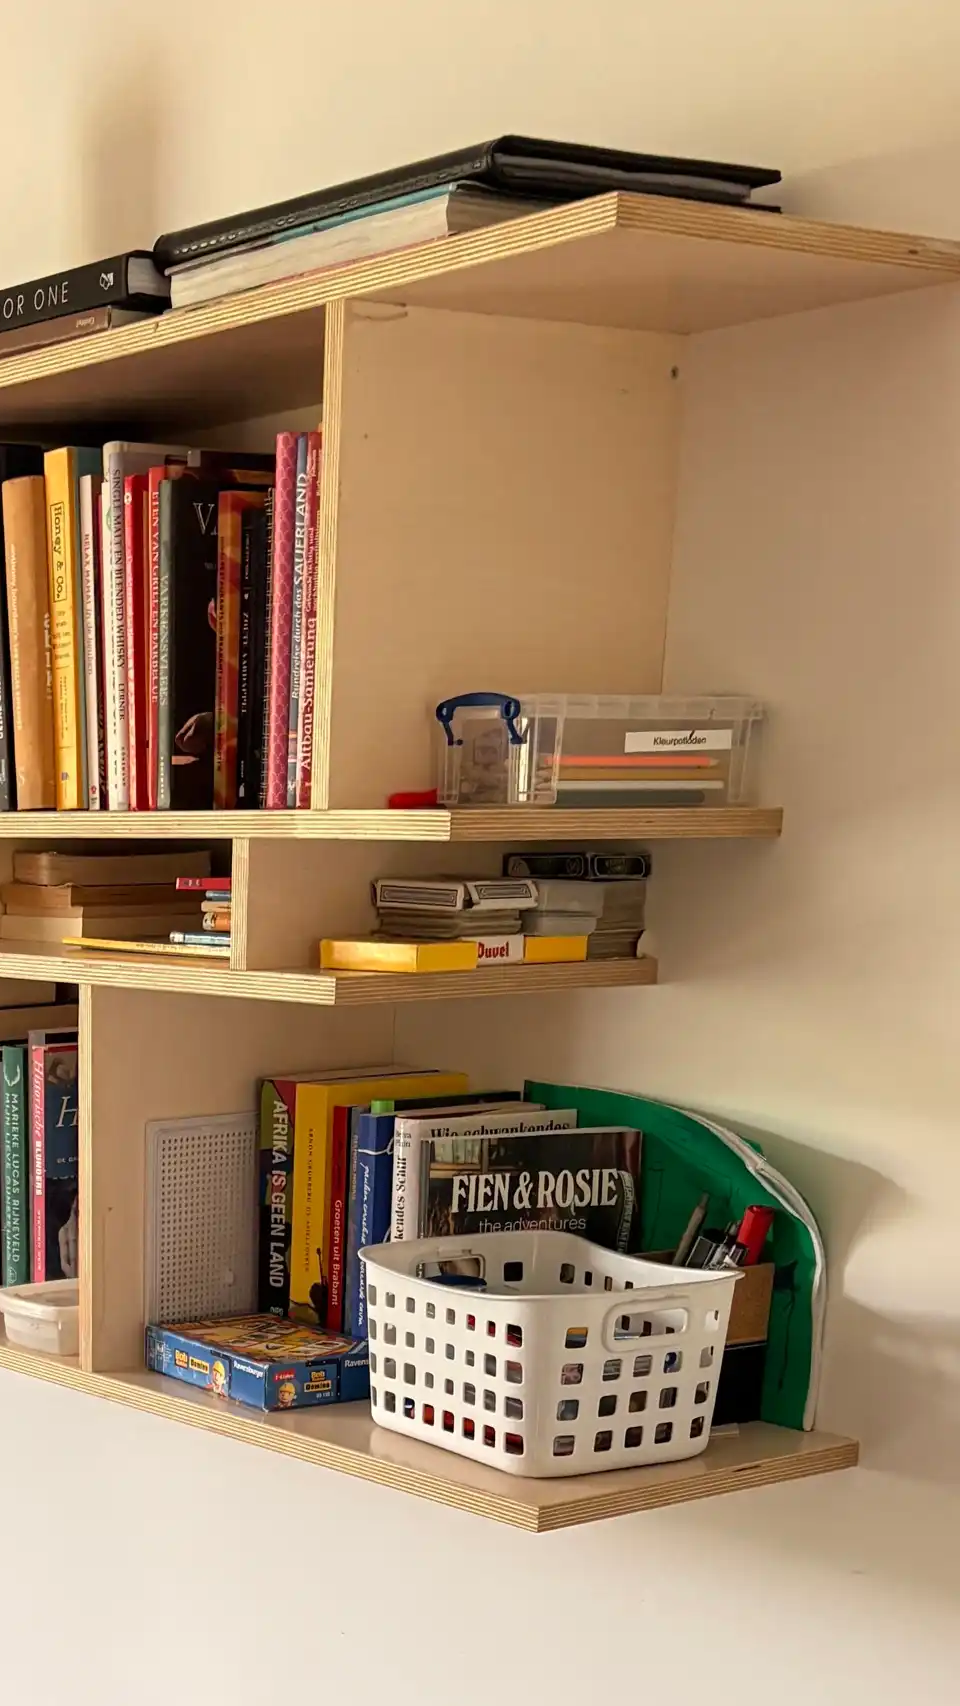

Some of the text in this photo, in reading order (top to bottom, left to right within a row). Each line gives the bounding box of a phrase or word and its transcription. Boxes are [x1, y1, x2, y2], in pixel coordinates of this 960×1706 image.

[34, 281, 70, 307] ONE
[112, 469, 121, 513] SINGLE
[151, 491, 159, 527] ETEN
[52, 504, 65, 600] Honey & Co.
[114, 515, 122, 548] MALT
[151, 531, 159, 564] VAN
[115, 550, 123, 565] EN
[115, 568, 124, 622] BLENDED
[152, 565, 160, 608] GRILL
[292, 473, 308, 699] Rundreise durch das SAUERLAND
[152, 611, 160, 628] EN
[160, 574, 169, 706] VARKENSVLEES
[116, 624, 125, 669] WHISKY
[300, 617, 317, 771] Altbau-Sanierung
[477, 940, 510, 959] Duvel
[33, 1060, 45, 1137] Historische
[272, 1100, 288, 1164] AFRIKA
[10, 1093, 20, 1262] MARIEKE LUCAS RIJNEVELD
[35, 1140, 43, 1196] BLUNDERS
[271, 1169, 287, 1187] IS
[451, 1172, 516, 1213] FIEN
[513, 1171, 534, 1211] &
[537, 1168, 619, 1215] ROSIE
[270, 1191, 286, 1237] GEEN
[479, 1216, 587, 1233] the adventures
[269, 1242, 284, 1288] LAND
[331, 1199, 343, 1306] Groeten uit Brabant
[233, 1360, 264, 1378] Ravensburger
[344, 1359, 369, 1369] Ravens
[305, 1383, 330, 1391] Domino
